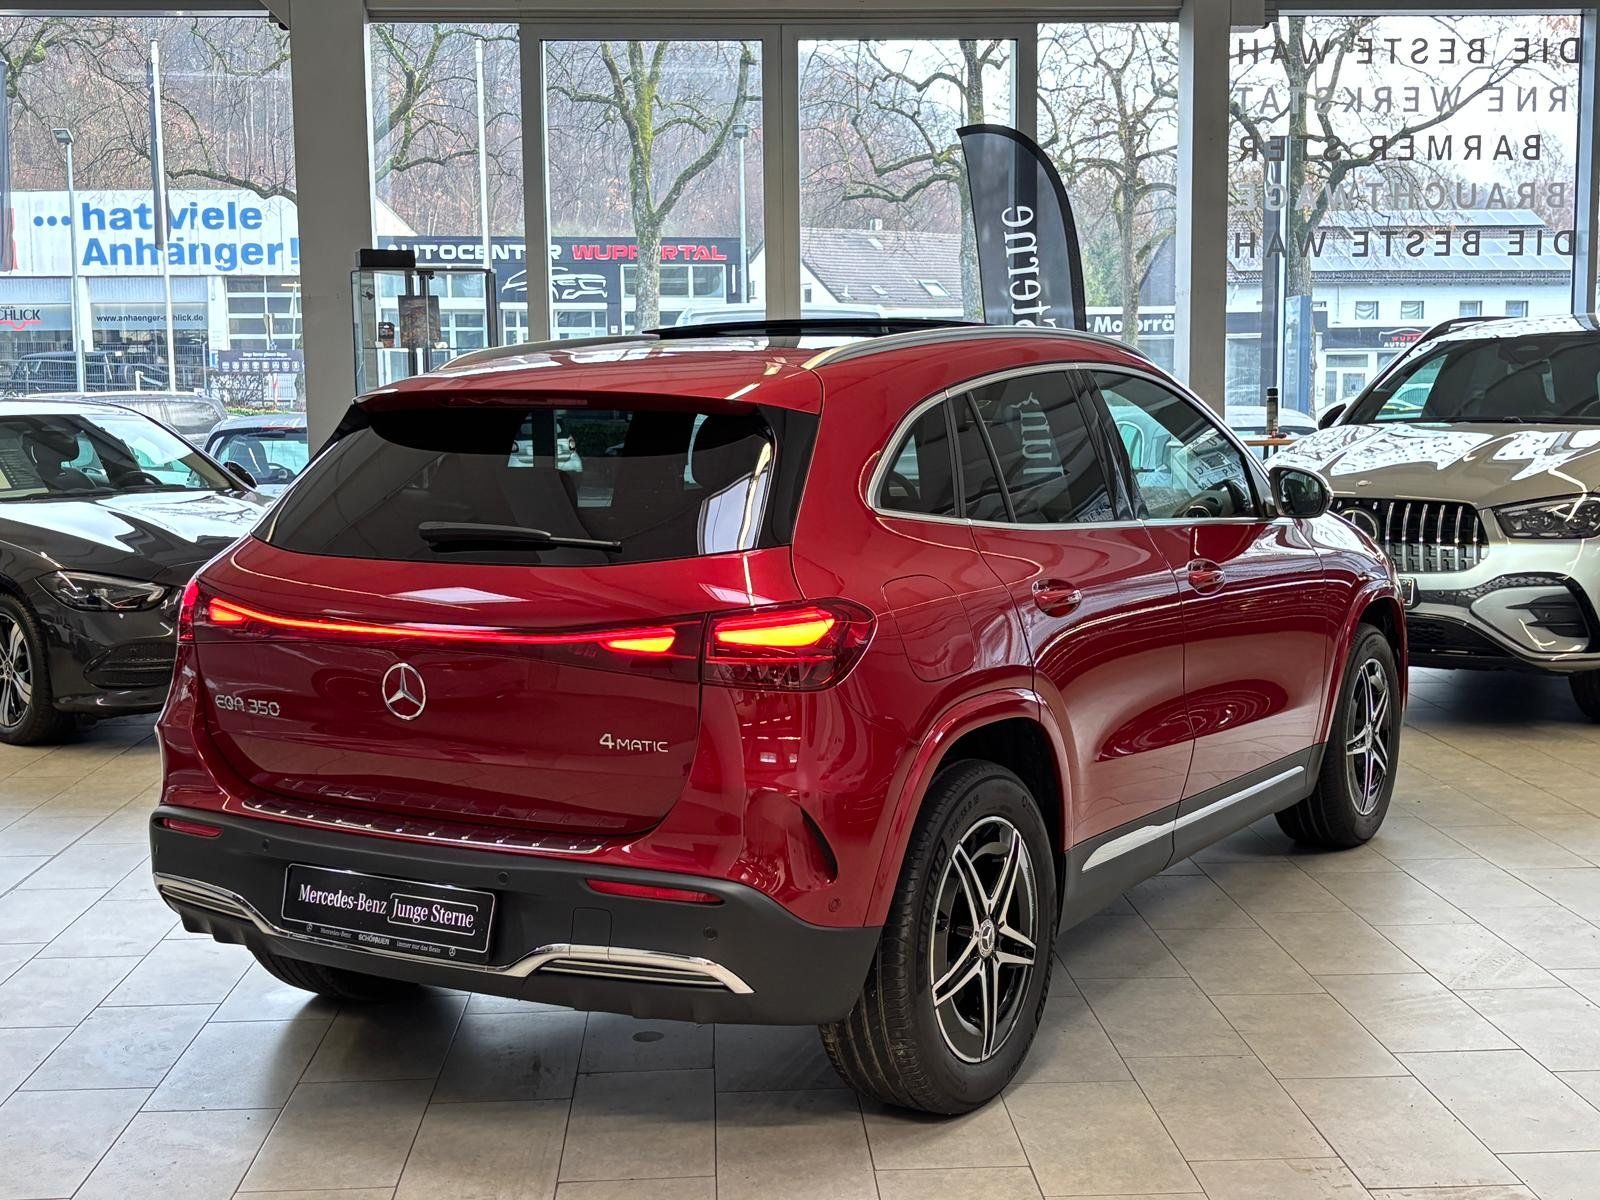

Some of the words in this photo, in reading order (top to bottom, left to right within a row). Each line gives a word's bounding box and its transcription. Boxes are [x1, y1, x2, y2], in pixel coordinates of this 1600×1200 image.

[82, 202, 153, 231] hat
[169, 202, 263, 231] viele
[82, 237, 299, 272] Anhänger!
[387, 243, 562, 261] UTOCENTR
[572, 244, 728, 261] WUPPRTAL
[1093, 314, 1175, 333] Morrä
[214, 693, 246, 712] EQA
[247, 698, 281, 717] 350
[599, 733, 669, 753] 4MATIC
[298, 883, 387, 915] Mercedes-Benz
[391, 898, 429, 923] Junge
[430, 904, 475, 929] Sterne
